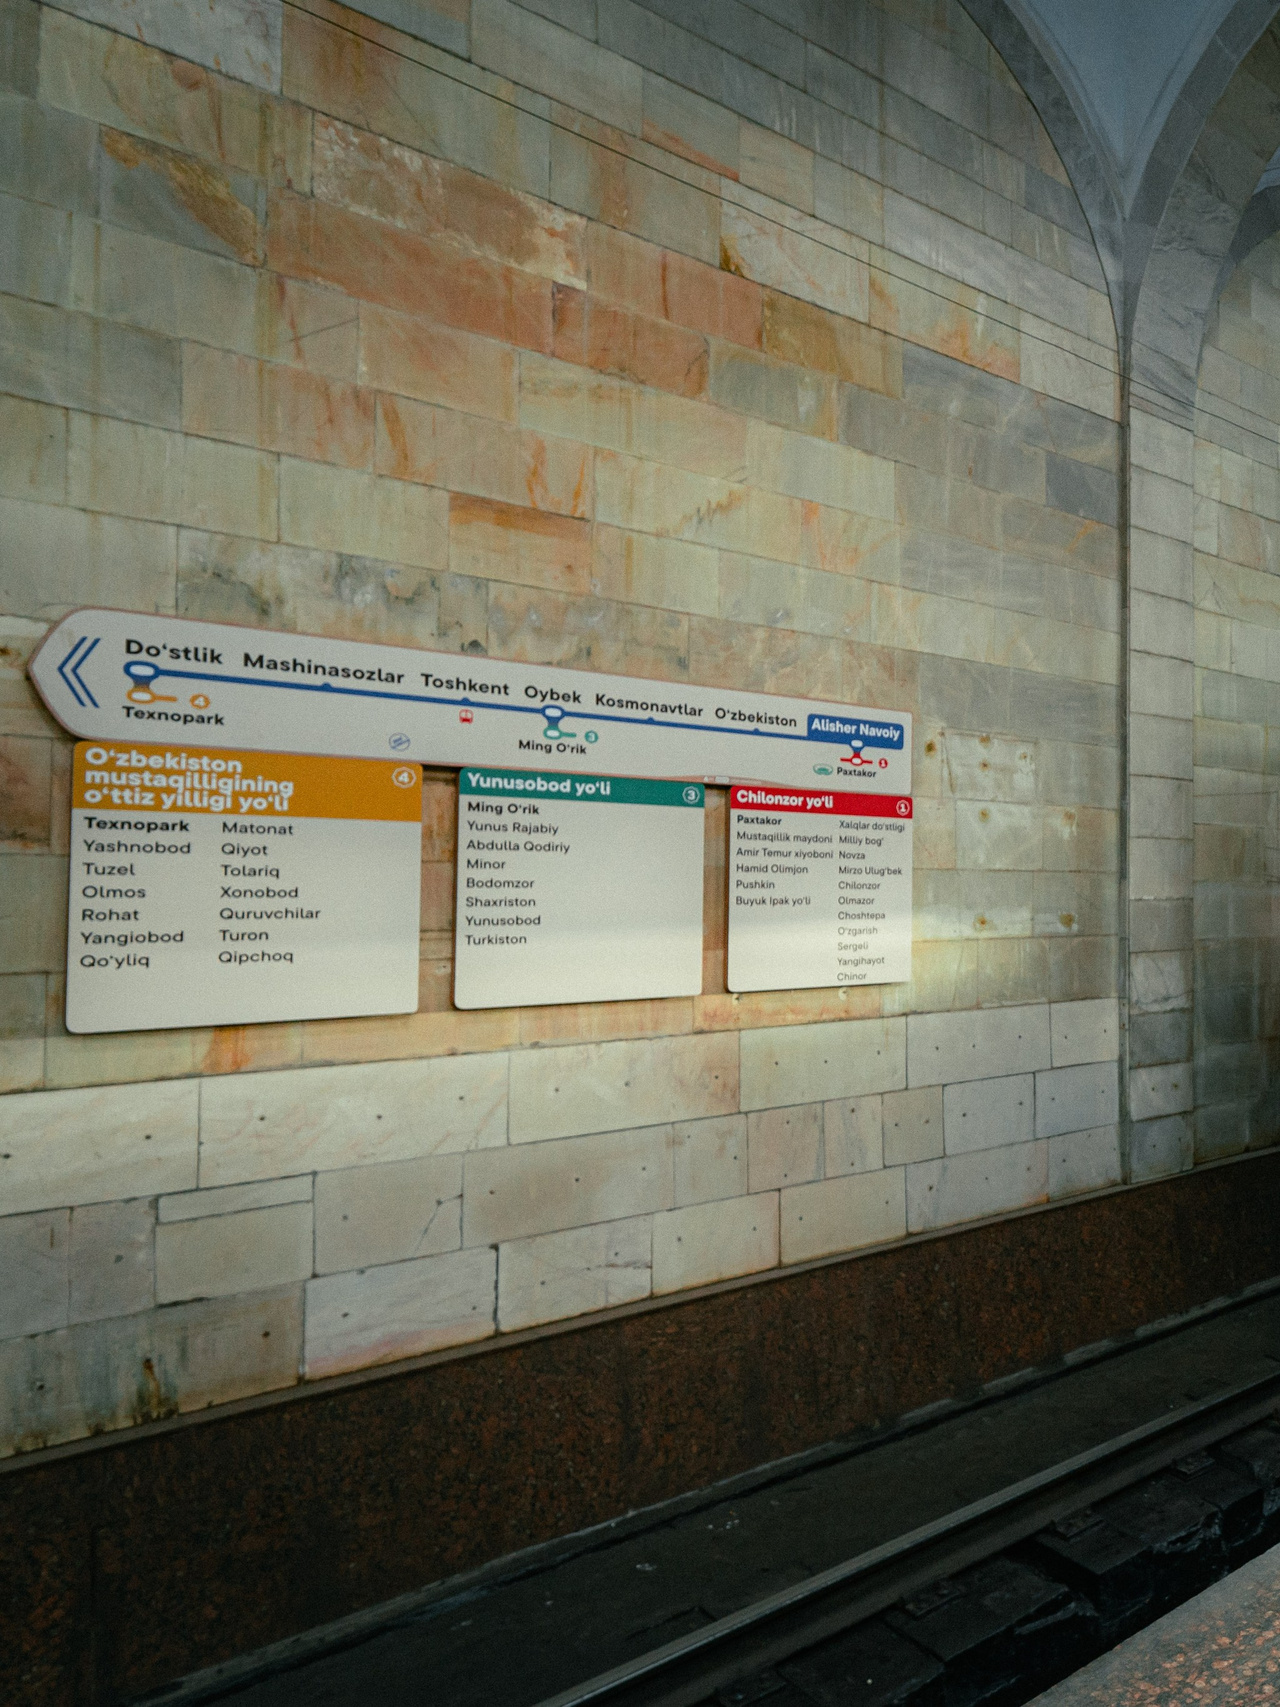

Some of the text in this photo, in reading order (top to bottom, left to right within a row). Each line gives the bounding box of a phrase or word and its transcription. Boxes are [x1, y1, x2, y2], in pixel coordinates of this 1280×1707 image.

[243, 651, 405, 685] Mashinasozlar
[420, 673, 510, 697] Toshkent
[523, 684, 582, 708] Oybek
[595, 693, 703, 718] Kosmonavtlar
[811, 718, 857, 735] Alisher
[859, 725, 900, 741] Navoiy
[122, 705, 225, 727] Texnopark
[518, 738, 553, 755] Ming
[836, 766, 876, 778] Paxtakor
[85, 770, 294, 797] mustaqilligining
[468, 773, 571, 793] Yunusobod
[161, 789, 233, 813] yilligi
[736, 789, 804, 806] Chilonzor
[467, 802, 503, 816] Ming
[84, 816, 190, 833] Texnopark
[737, 815, 782, 826] Paxtakor
[838, 820, 870, 832] Xalqlar
[222, 822, 294, 836] Matonat
[466, 821, 559, 836] Yunus Rajabiy
[737, 831, 833, 845] Mustaqillik maydoni
[838, 835, 863, 846] Milliy
[84, 840, 192, 855] Yashnobod
[221, 843, 268, 858] Qiyot
[466, 840, 571, 855] Abdulla Qodiriy
[736, 847, 834, 861] Amir Temur xiyoboni
[838, 850, 865, 859] Novza
[82, 862, 135, 877] Tuzel
[466, 858, 506, 870] Minor
[736, 864, 809, 876] Hamid Olimjon
[838, 865, 862, 875] Mirzo
[221, 864, 280, 879] Tolariq
[466, 877, 535, 889] Bodomzor
[735, 880, 775, 890] Pushkin
[838, 880, 881, 890] Chilonzor
[82, 885, 146, 899] Olmos
[220, 886, 299, 899] Xonobod
[465, 896, 536, 907] Shaxriston
[735, 895, 767, 907] Buyuk
[769, 896, 789, 907] Ipak
[838, 896, 875, 906] Olmazor
[82, 908, 139, 921] Rohat
[219, 907, 321, 921] Quruvchilar
[837, 910, 886, 922] Choshtepa
[465, 915, 542, 927] Yunusobod
[81, 930, 185, 946] Yangiobod
[219, 929, 269, 941] Turon
[465, 934, 528, 945] Turkiston
[837, 941, 868, 952] Sergeli
[218, 950, 294, 966] Qipchoq
[837, 955, 885, 968] Yangihayot
[836, 971, 867, 981] Chinor
